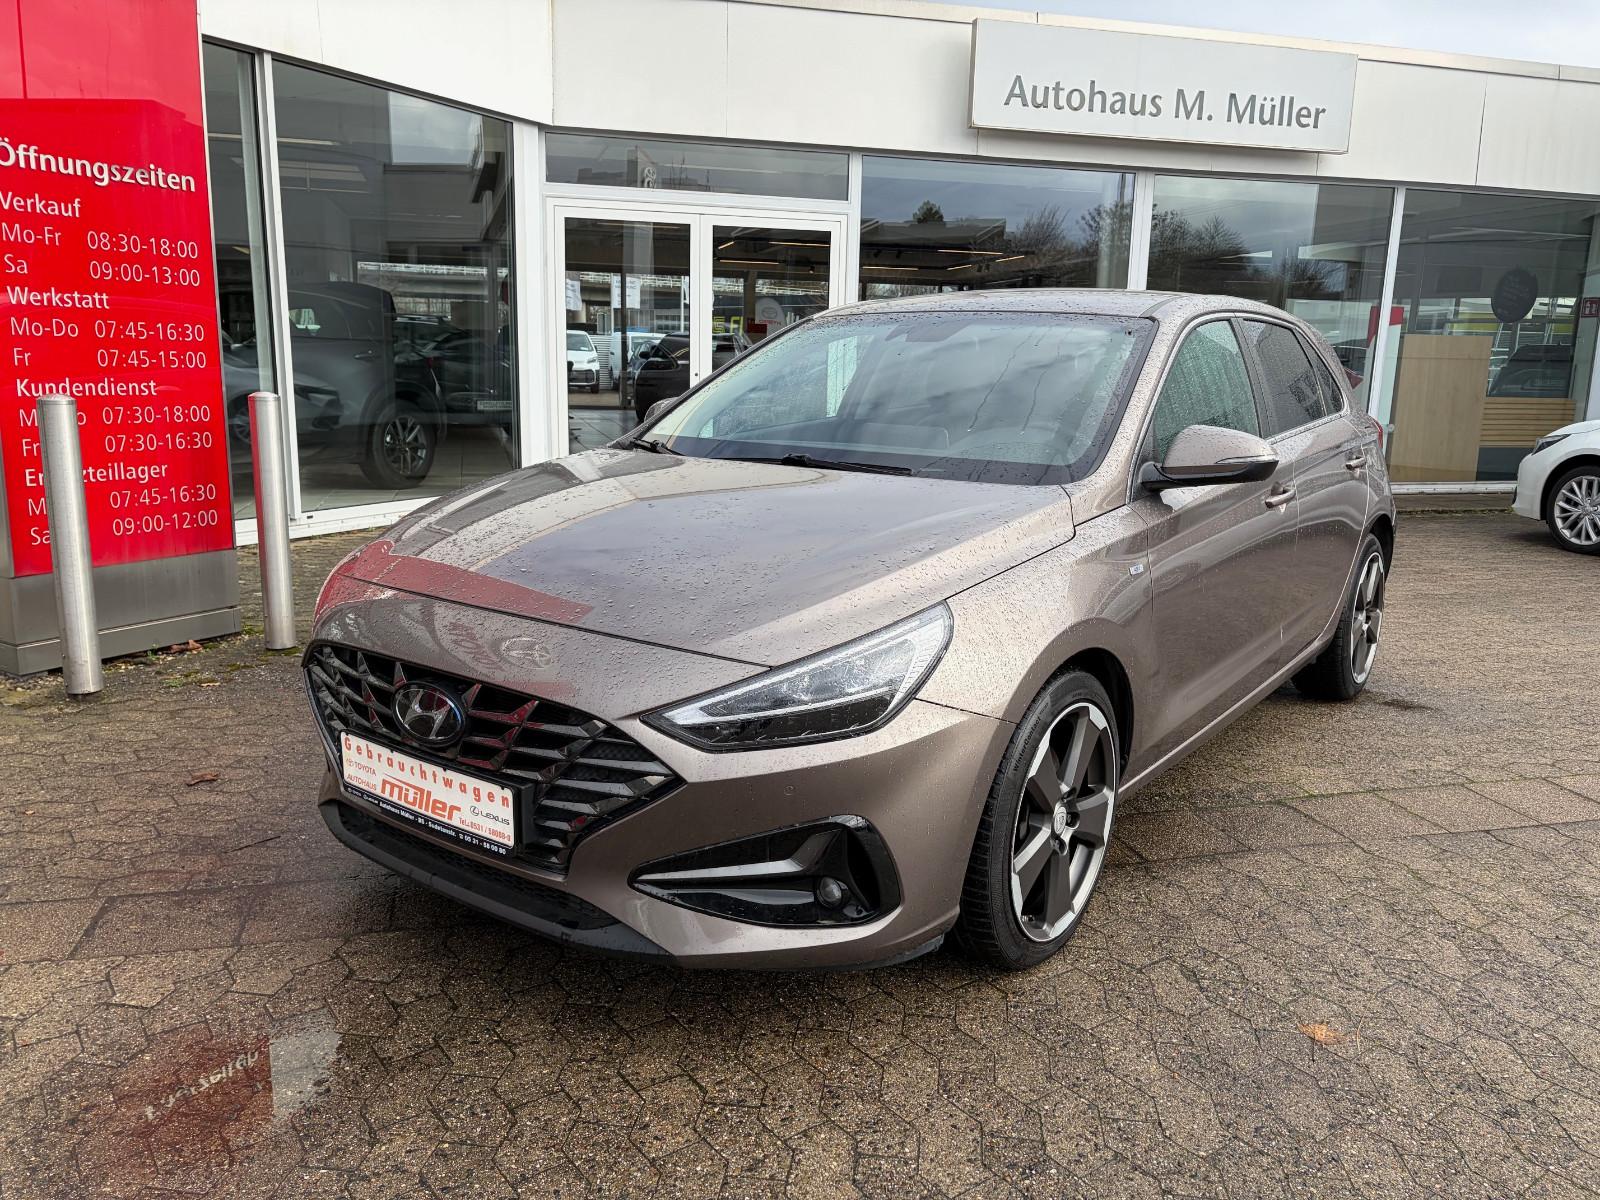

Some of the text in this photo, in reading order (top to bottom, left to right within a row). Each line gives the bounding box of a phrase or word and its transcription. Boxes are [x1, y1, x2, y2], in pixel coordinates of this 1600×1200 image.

[1004, 75, 1327, 129] Autohaus M. Müller
[0, 136, 196, 192] Öffnungszeiten
[0, 191, 81, 218] Verkauf
[1, 222, 198, 259] Mo-Fr 08:30-18:00
[4, 253, 201, 287] Sa 09:00-13:00
[6, 285, 110, 310] Werkstatt
[10, 316, 205, 342] Mo-Do 07:45-16:30
[13, 347, 207, 369] Fr 07:45-15:00
[16, 377, 157, 398] Kundendienst
[102, 405, 211, 425] 07:30-18:00
[22, 431, 212, 457] Fr 07:30-16:30
[109, 483, 216, 509] 07:45-16:30
[112, 509, 218, 536] 09:00-12:00
[355, 761, 377, 776] TOYOTA
[346, 773, 377, 791] AUTOHAUS
[480, 810, 510, 826] LEXUS
